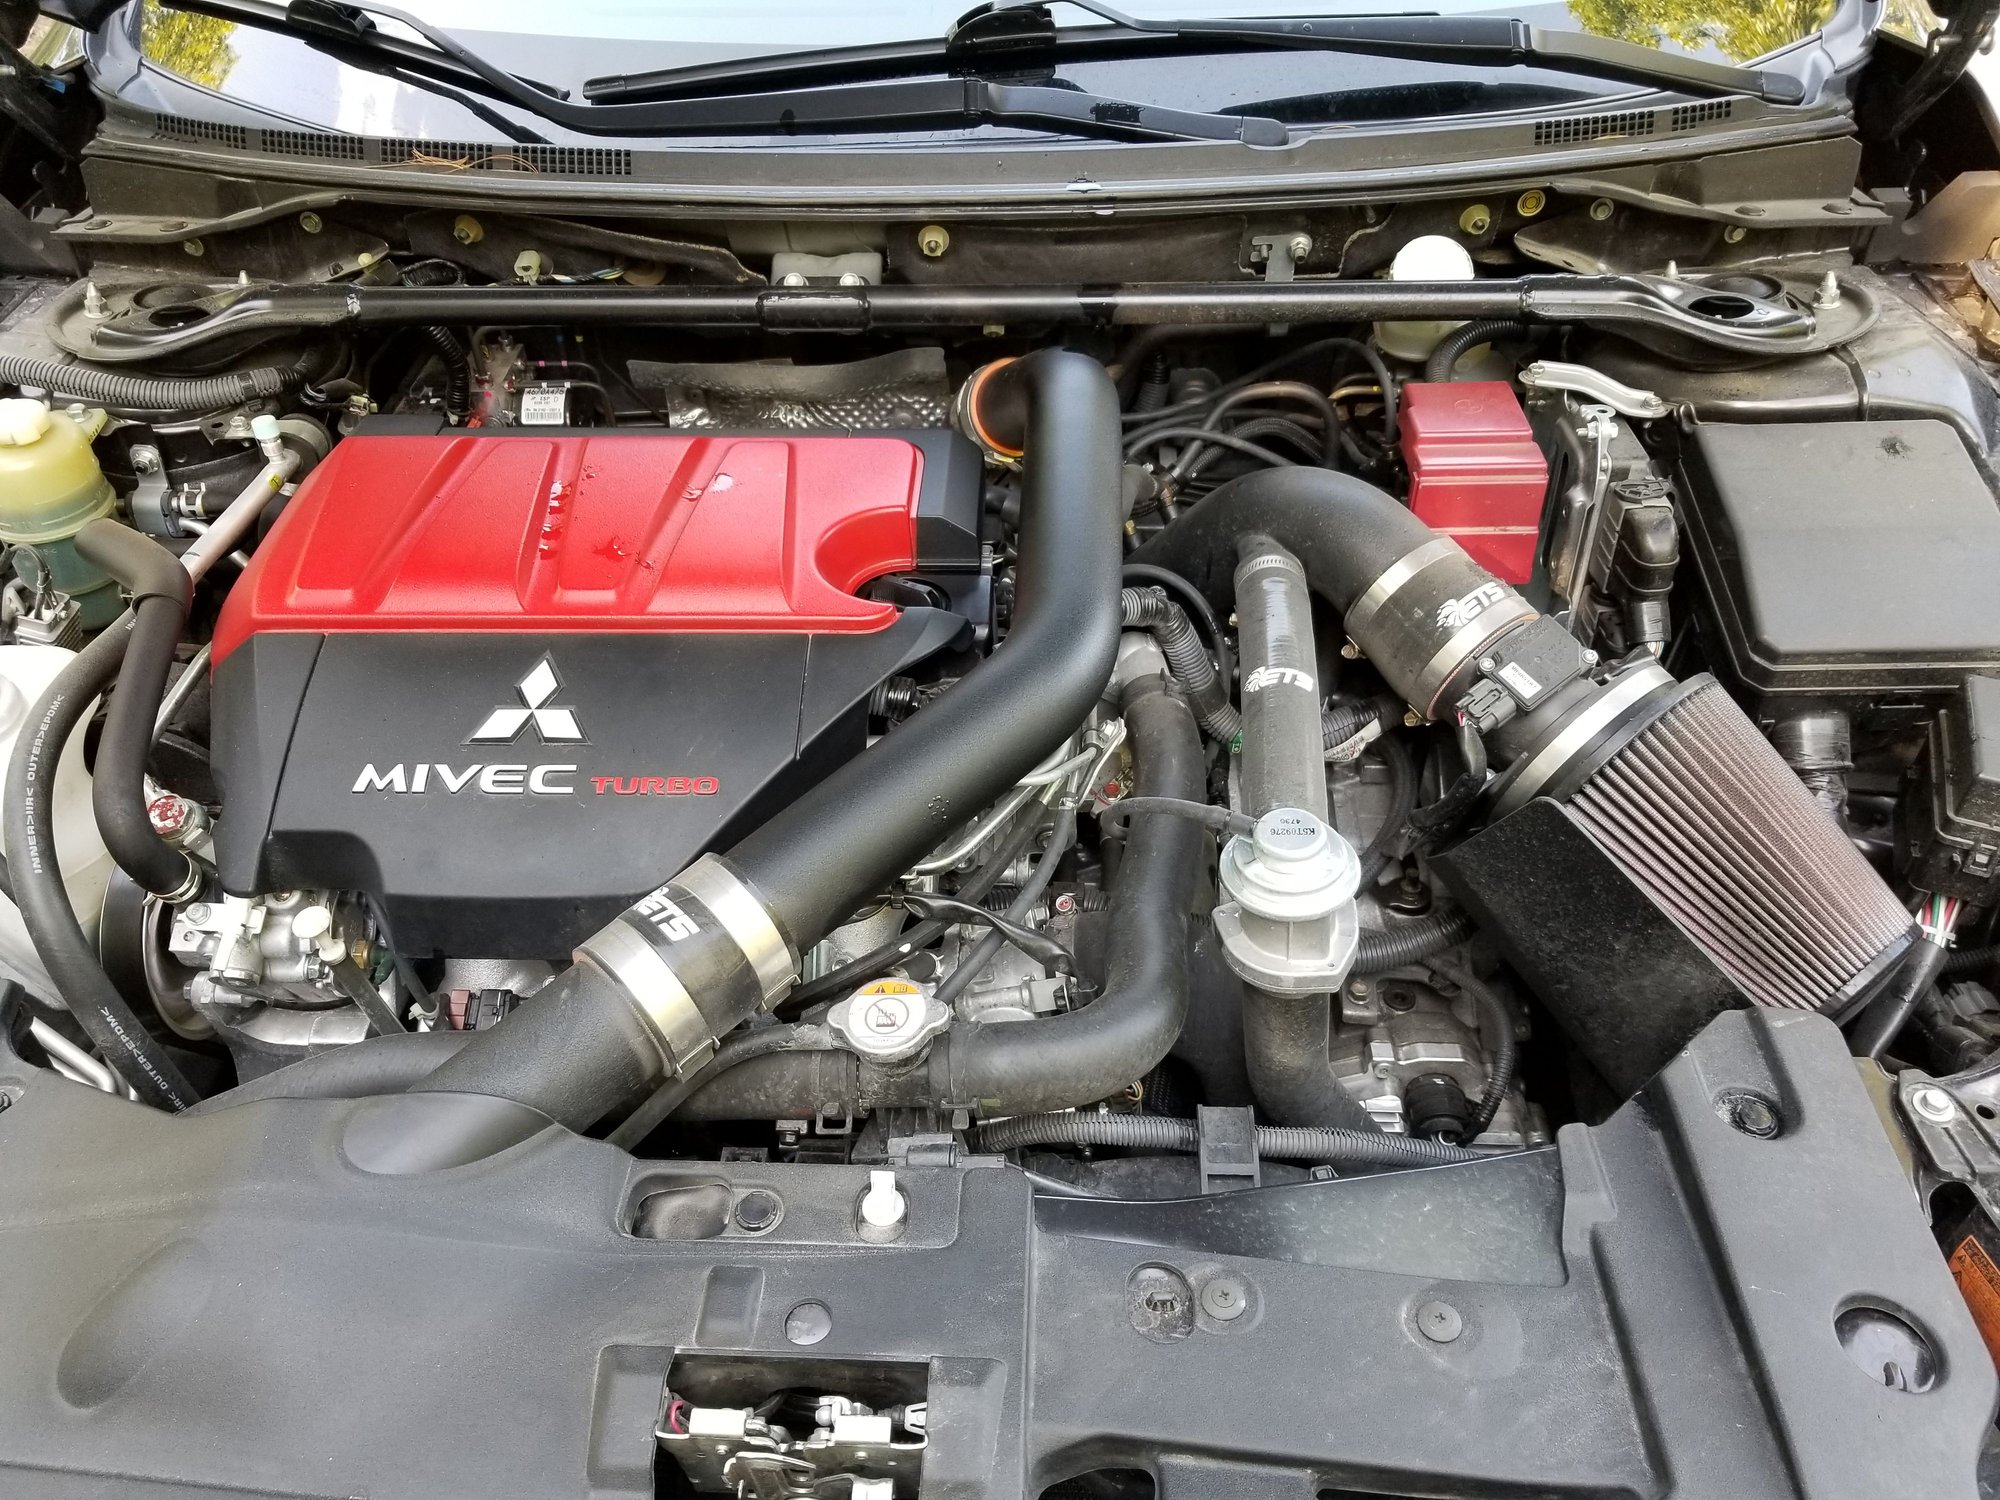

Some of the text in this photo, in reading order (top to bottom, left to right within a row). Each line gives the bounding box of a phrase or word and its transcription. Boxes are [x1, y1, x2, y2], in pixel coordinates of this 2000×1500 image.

[351, 763, 721, 796] MIVEC TURBO
[637, 892, 700, 942] ETS
